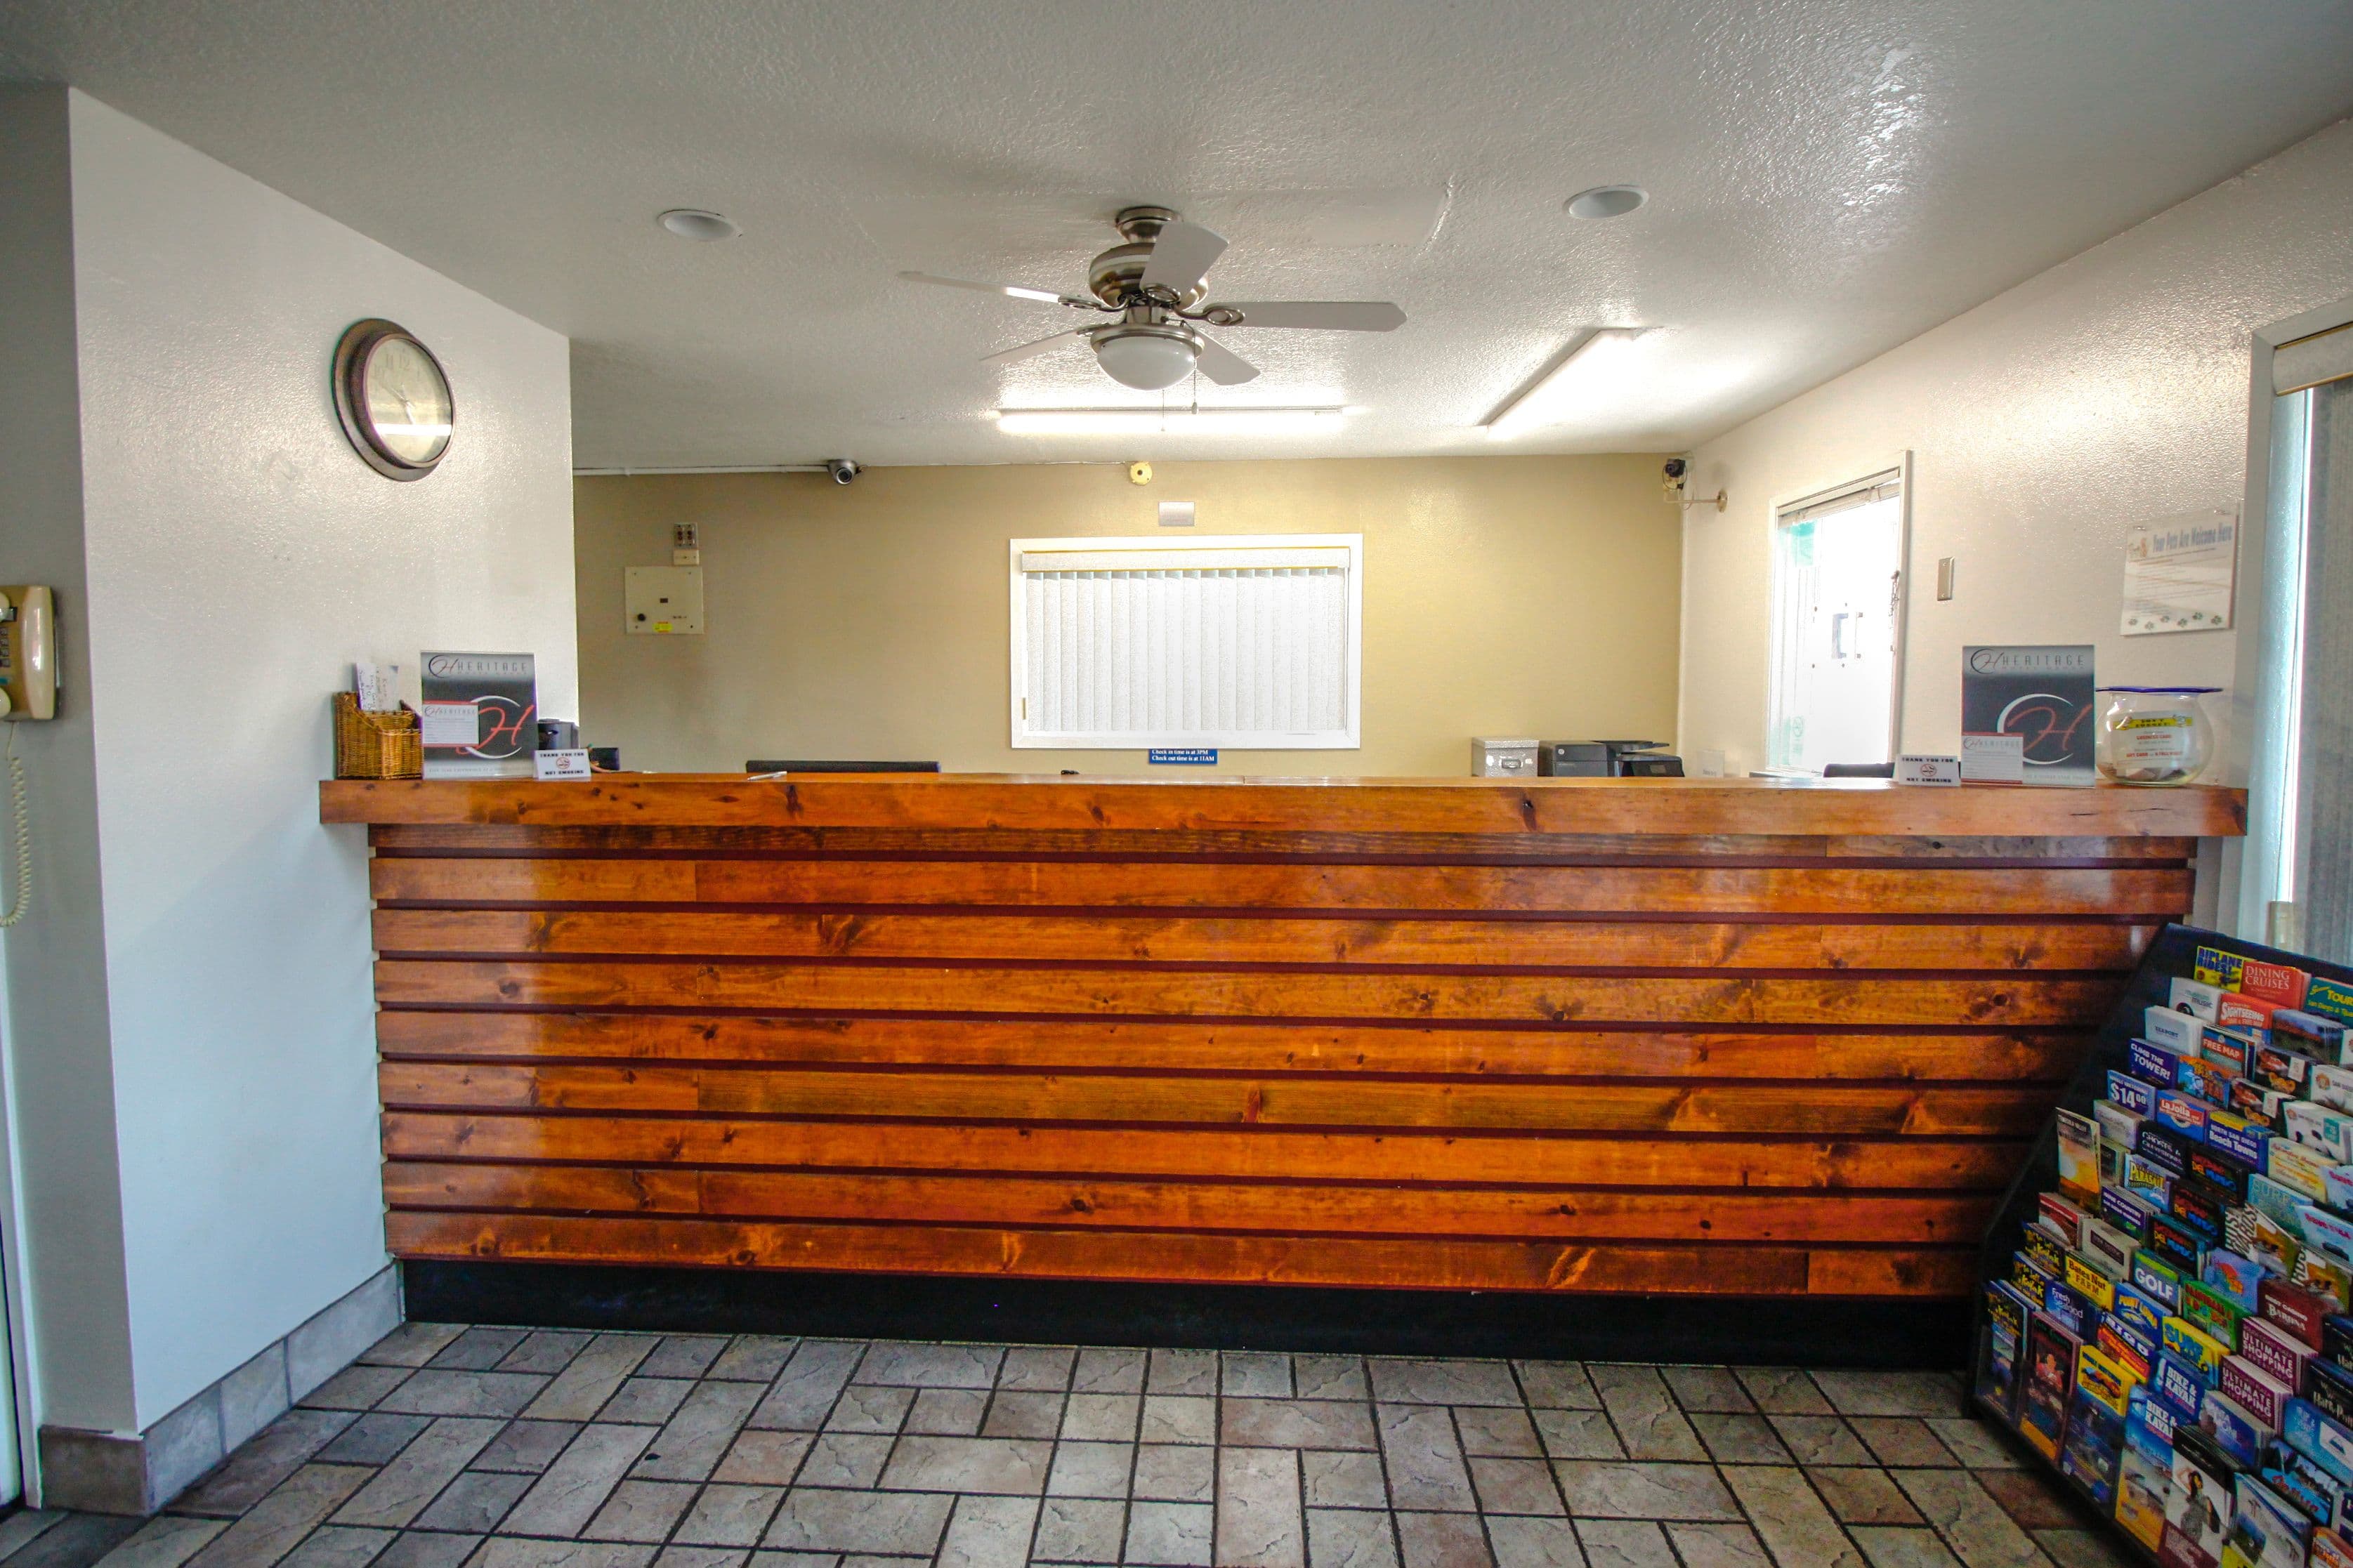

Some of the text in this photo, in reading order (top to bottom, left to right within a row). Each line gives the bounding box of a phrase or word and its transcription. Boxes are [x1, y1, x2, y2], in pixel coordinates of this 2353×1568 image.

[457, 661, 527, 672] HERITAGE
[2003, 655, 2085, 666] HERITAGE
[2245, 966, 2290, 981] DINING
[2245, 975, 2290, 990] CRUISES
[2130, 1043, 2164, 1065] CLIMB THE
[2203, 1039, 2241, 1058] FREE MAP
[2134, 1053, 2172, 1081] TOWER!
[2170, 1102, 2191, 1116] Jolla
[2209, 1130, 2233, 1149] Beach
[2234, 1138, 2258, 1159] Towns
[2069, 1258, 2106, 1291] Bates Nut
[2075, 1274, 2100, 1296] FARM
[2135, 1267, 2174, 1301] GOLF
[2052, 1287, 2071, 1306] Fresh
[2243, 1329, 2293, 1371] ULTIMATE
[2243, 1338, 2293, 1379] SHOPPING
[2165, 1377, 2196, 1409] KAYAK
[2168, 1365, 2197, 1395] BIKE &
[2222, 1366, 2272, 1407] ULTIMATE
[2222, 1376, 2272, 1418] SHOPPING
[2146, 1399, 2169, 1421] BIKE
[2170, 1416, 2178, 1428] &
